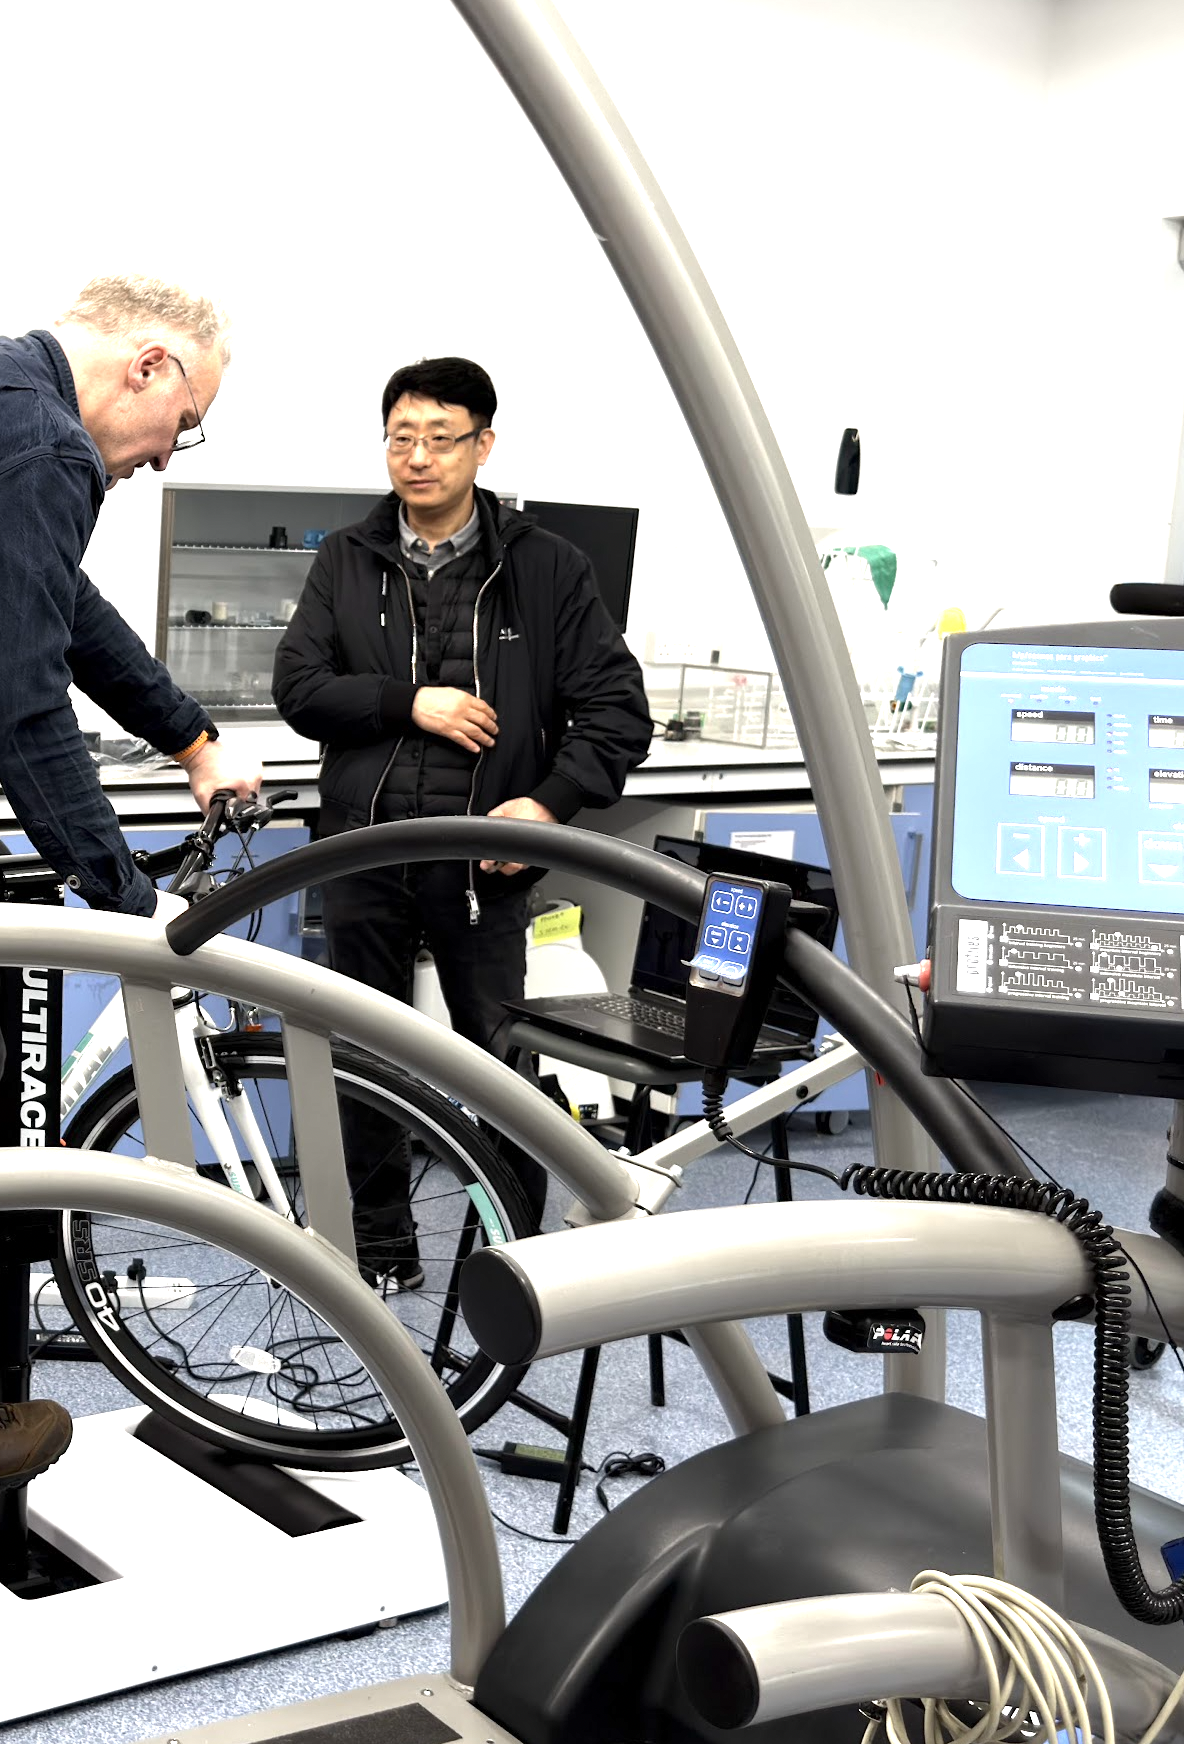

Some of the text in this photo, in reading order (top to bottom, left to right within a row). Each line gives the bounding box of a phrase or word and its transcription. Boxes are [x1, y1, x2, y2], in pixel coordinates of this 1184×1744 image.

[1016, 711, 1044, 720] speed
[1153, 716, 1174, 724] time
[1015, 763, 1054, 773] distance
[19, 968, 49, 1148] ULTIRACE
